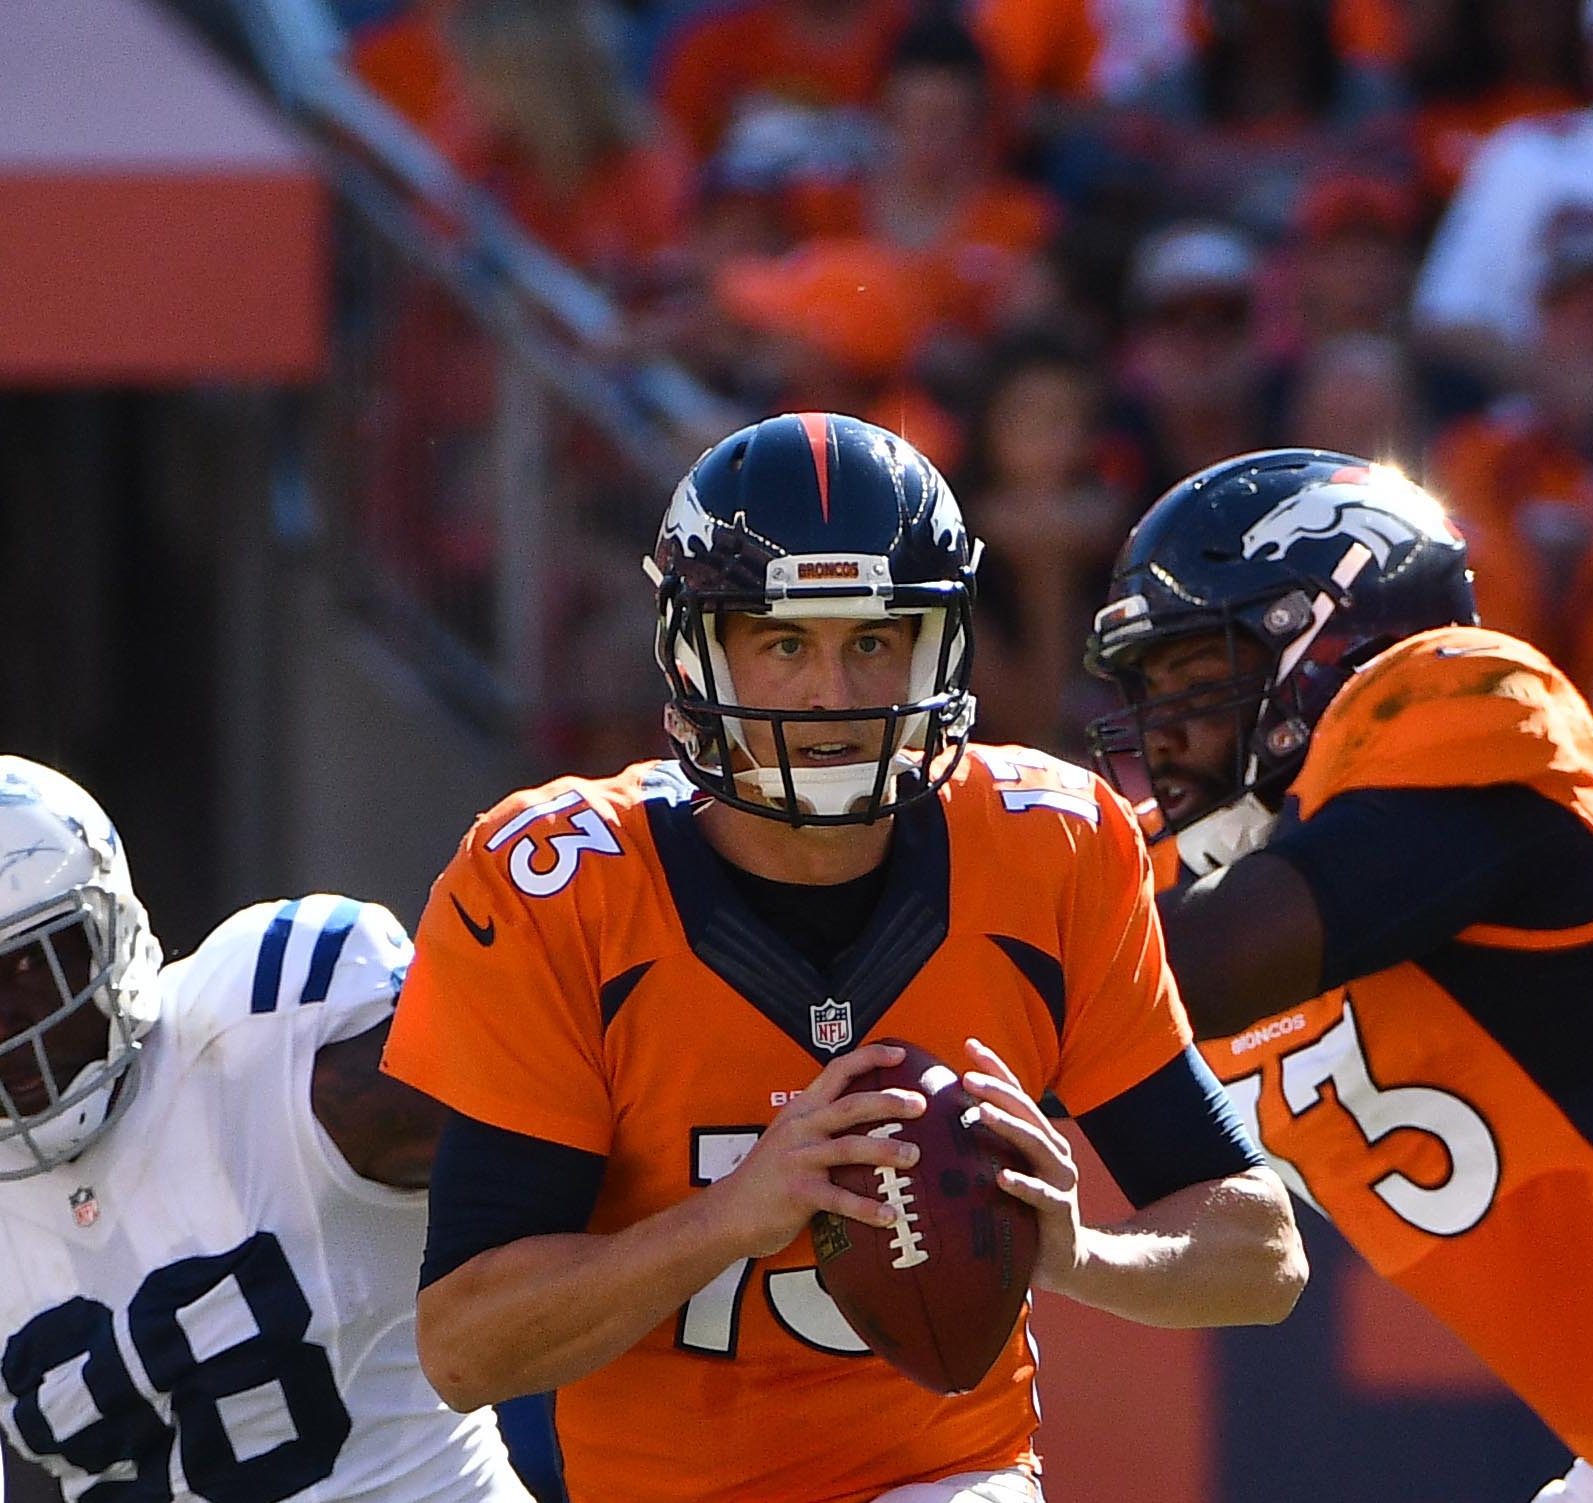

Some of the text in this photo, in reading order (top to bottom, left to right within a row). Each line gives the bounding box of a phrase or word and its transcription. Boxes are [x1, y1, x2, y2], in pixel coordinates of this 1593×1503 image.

[797, 562, 859, 580] BRONCOS
[484, 788, 625, 898] 13
[818, 1022, 846, 1042] NFL
